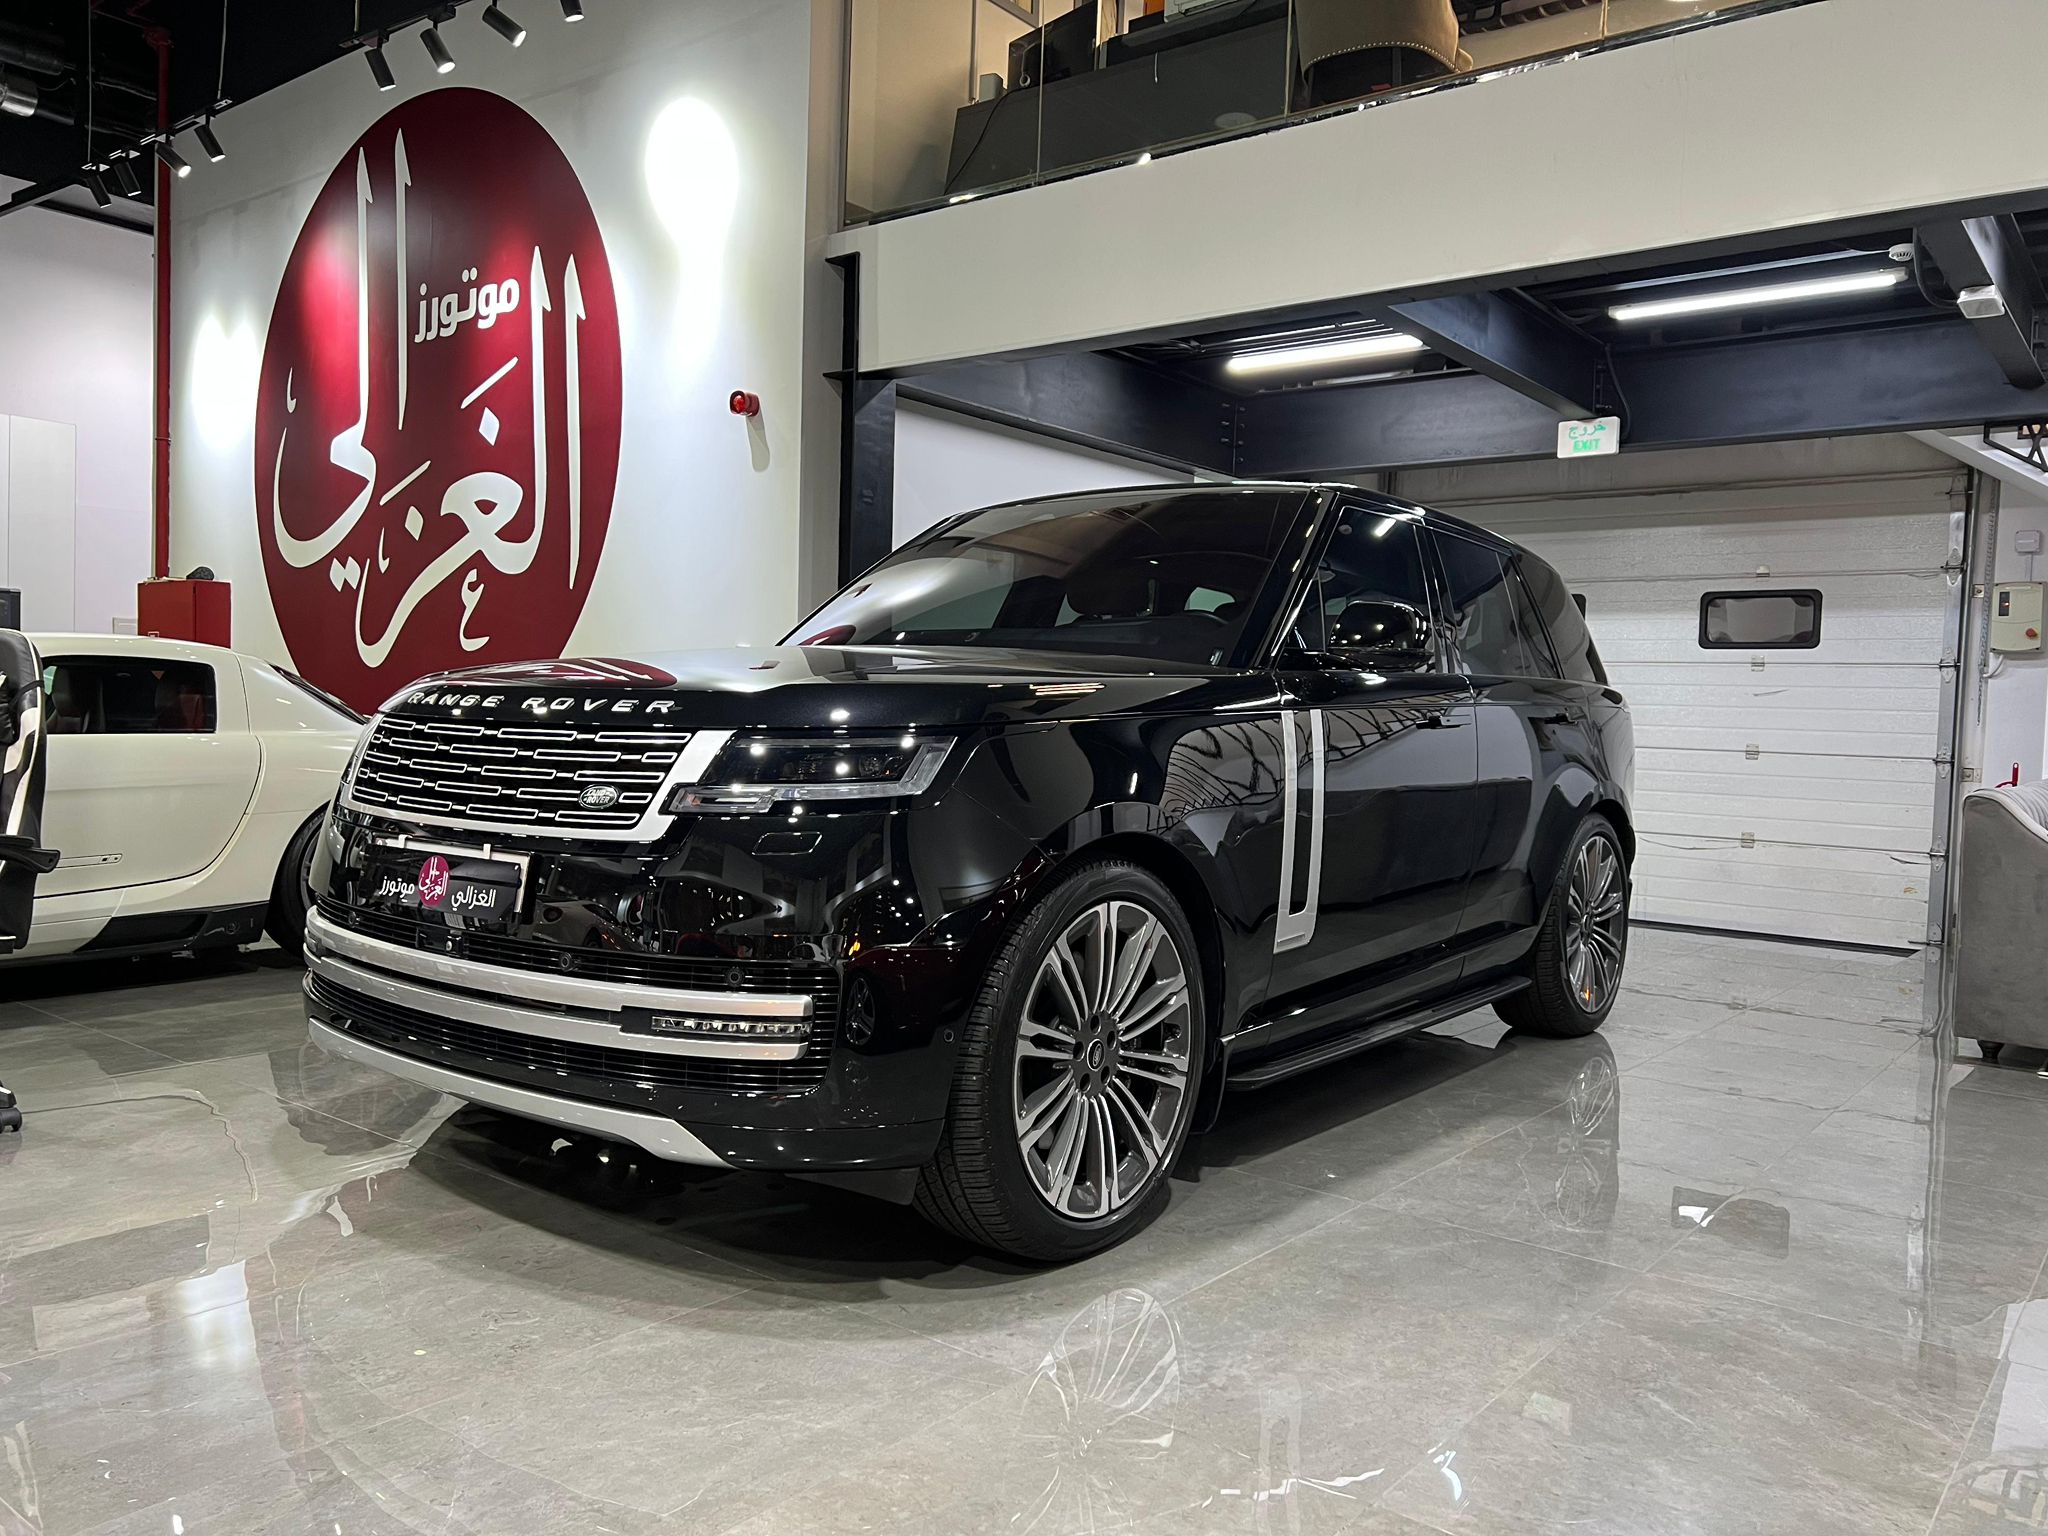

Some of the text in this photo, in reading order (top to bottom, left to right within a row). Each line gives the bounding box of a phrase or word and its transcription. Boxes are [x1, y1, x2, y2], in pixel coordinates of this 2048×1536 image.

[414, 267, 520, 343] موتورز
[1569, 421, 1606, 439] خروج
[1574, 440, 1600, 452] EXIT
[408, 692, 676, 713] RANGE ROVER
[378, 875, 497, 911] الغزالي موتورز
